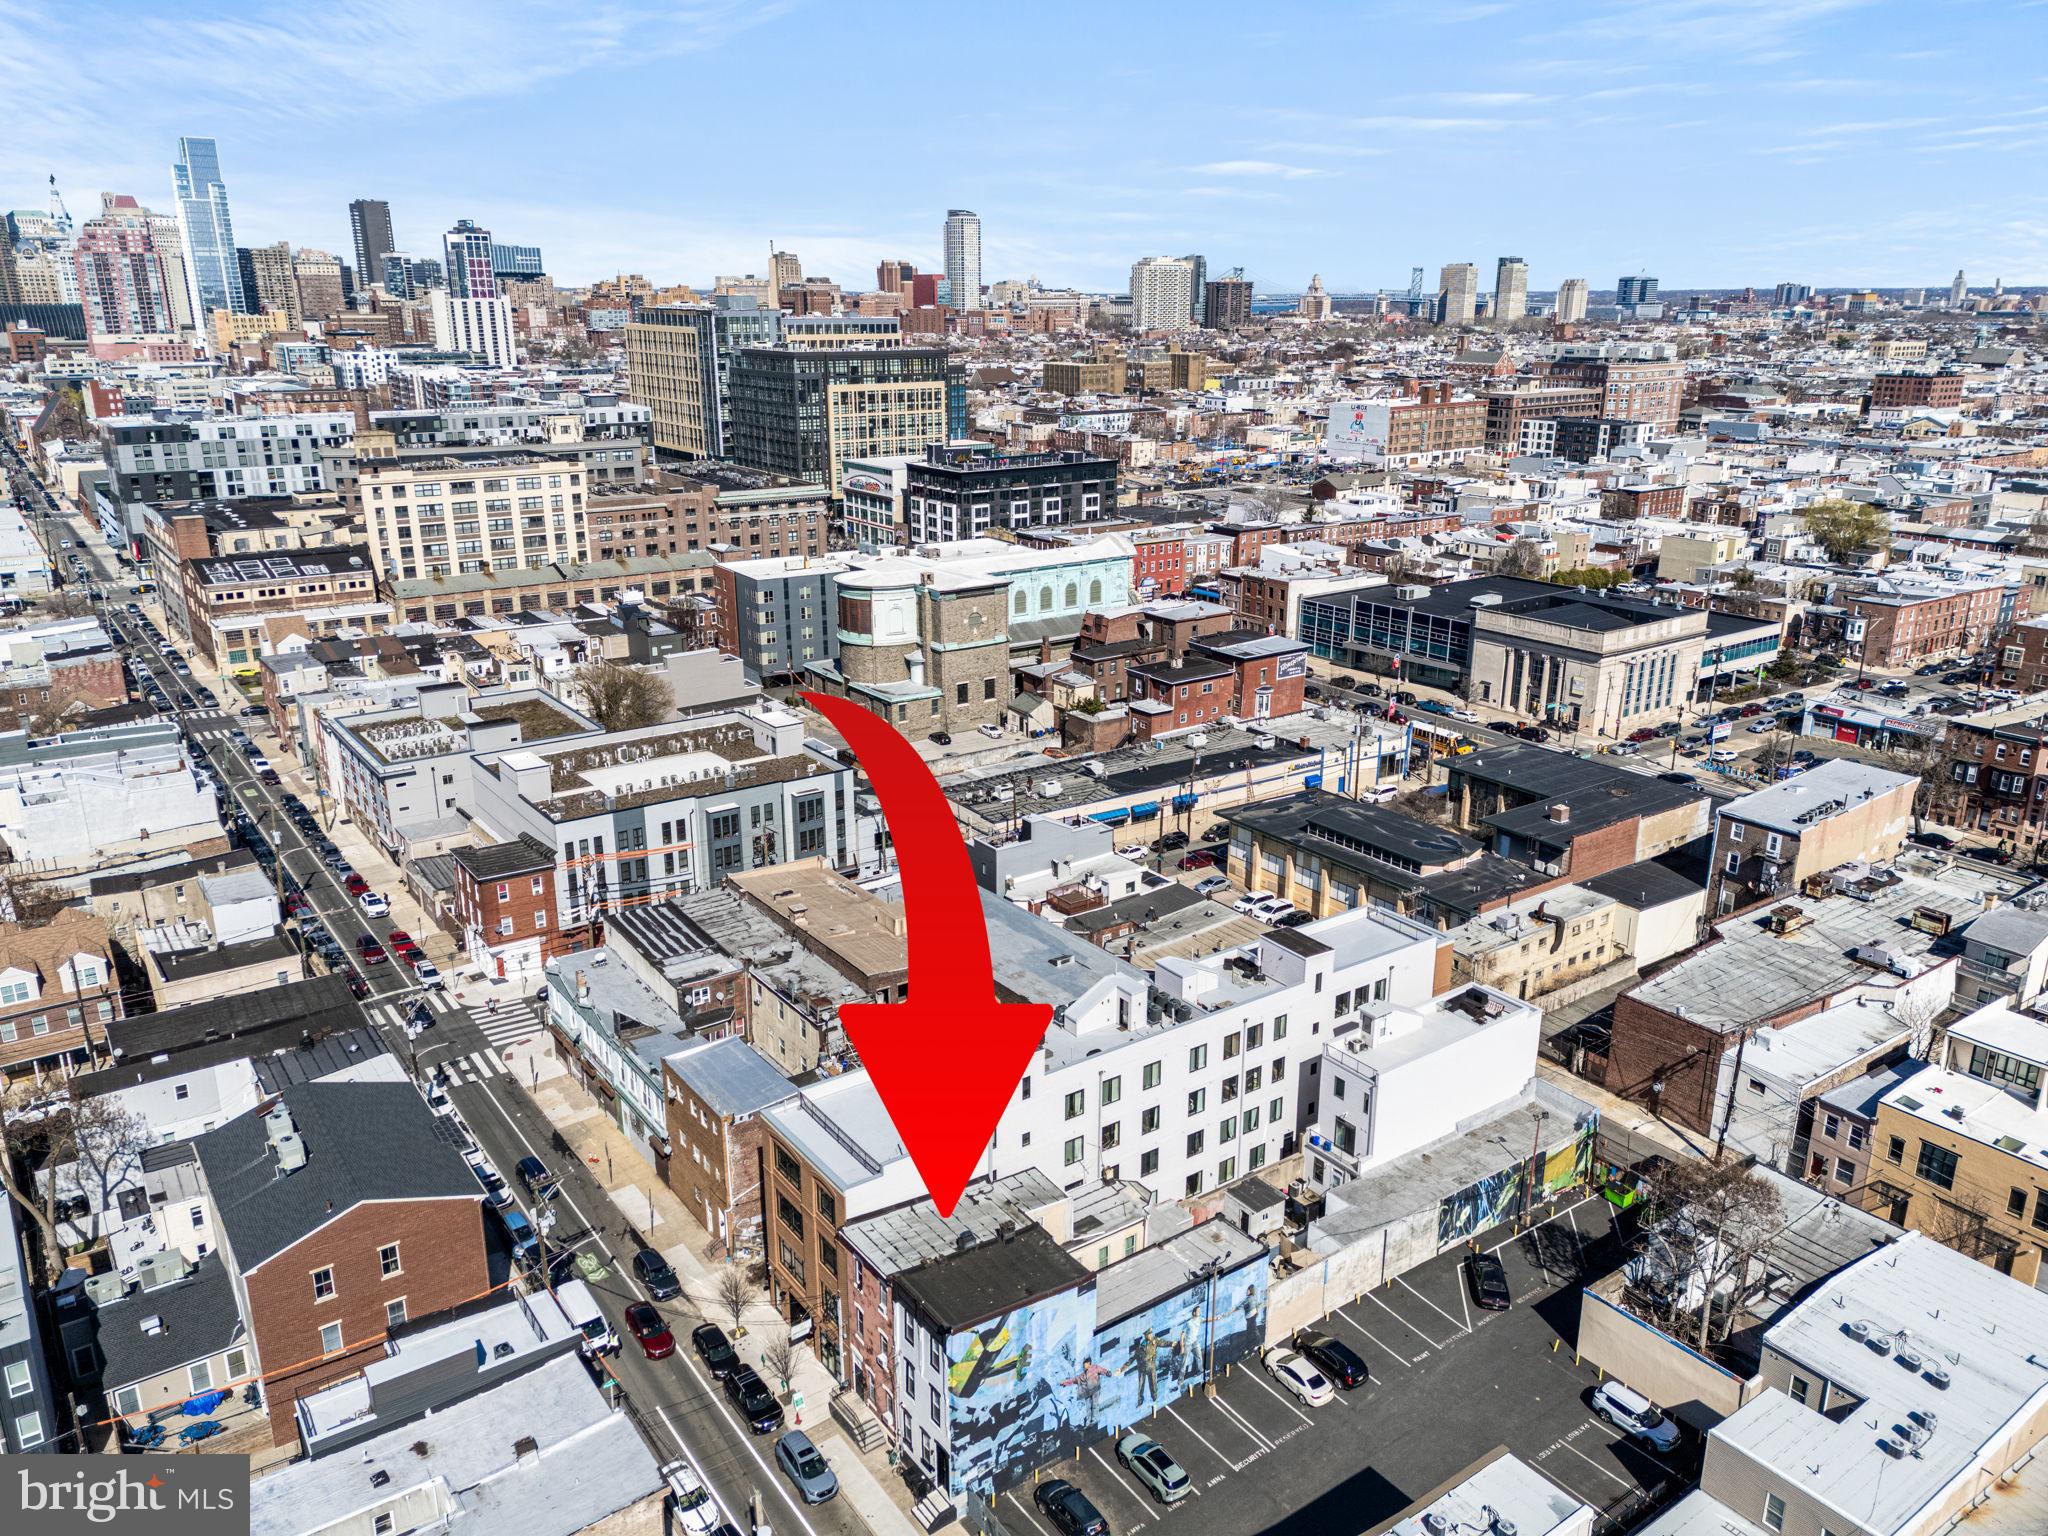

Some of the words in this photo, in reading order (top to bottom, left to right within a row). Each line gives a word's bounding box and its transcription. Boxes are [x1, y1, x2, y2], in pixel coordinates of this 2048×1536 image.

[1565, 1422, 1590, 1441] PATRIOT
[1235, 1448, 1266, 1471] SECURITY
[1536, 1442, 1562, 1461] PATRIOT
